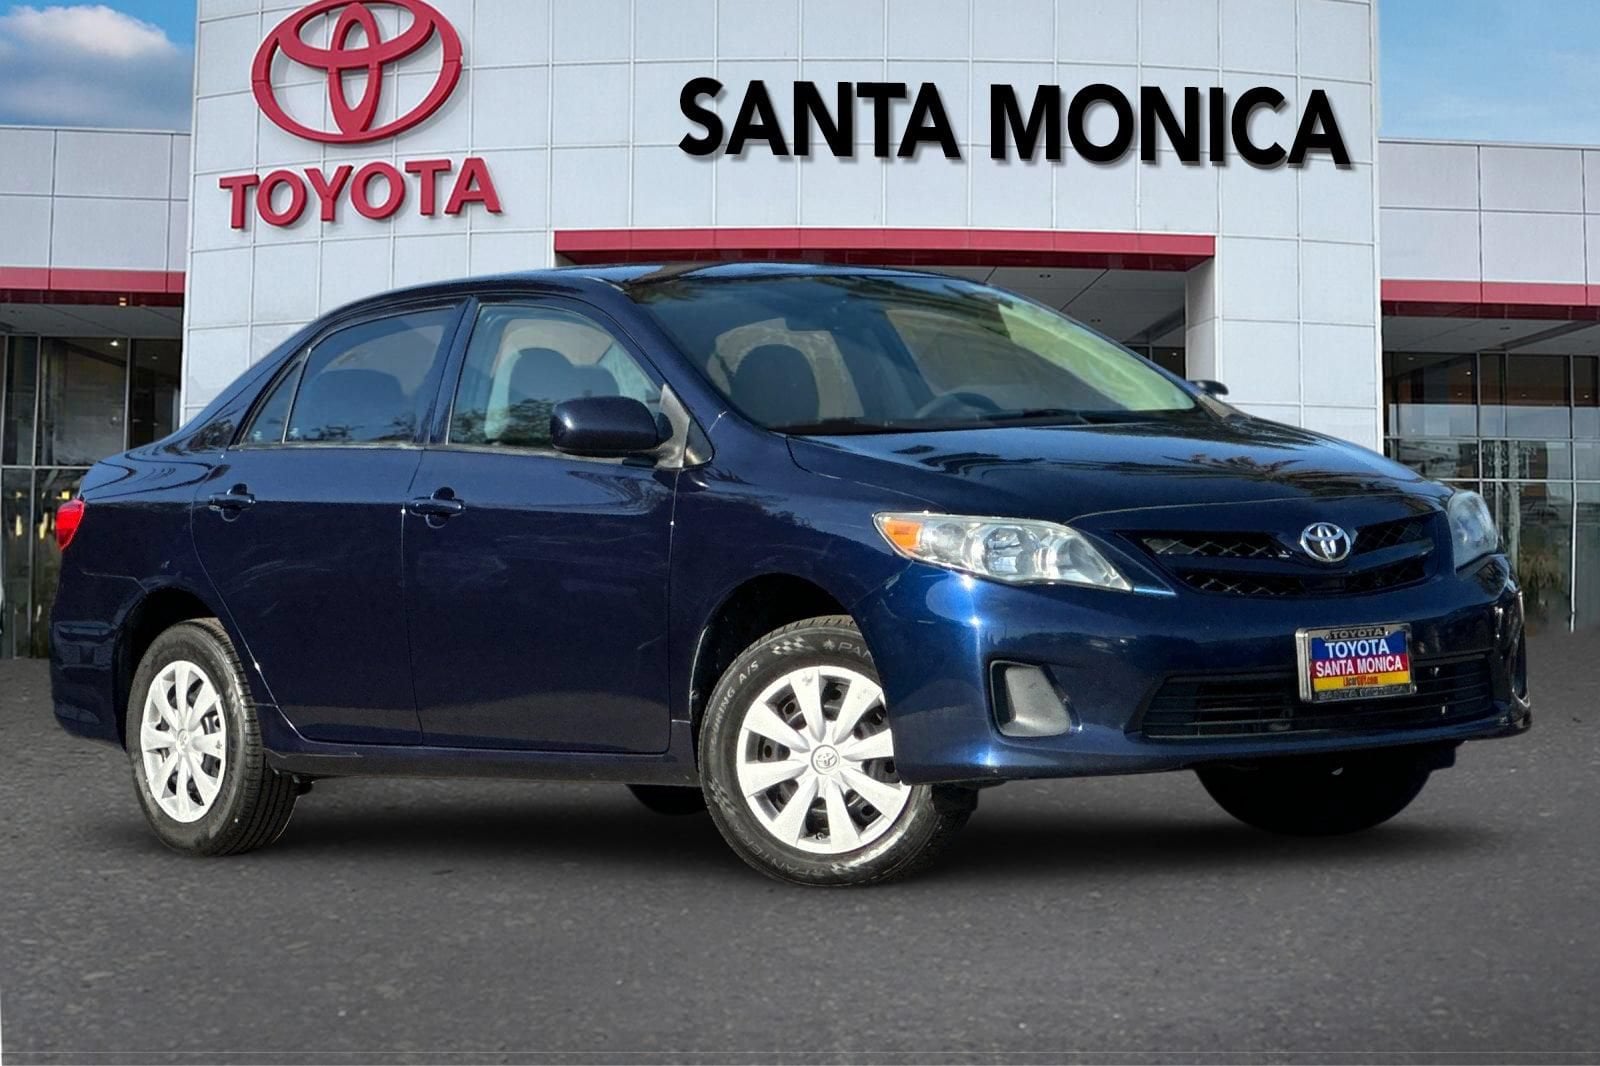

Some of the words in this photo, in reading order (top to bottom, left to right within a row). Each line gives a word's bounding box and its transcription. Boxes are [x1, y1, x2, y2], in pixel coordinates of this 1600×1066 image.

[678, 77, 962, 158] SANTA
[989, 83, 1351, 169] MONICA
[219, 157, 502, 229] TOYOTA
[1332, 628, 1384, 639] TOYOTA
[1324, 638, 1390, 658] TOYOTA
[739, 660, 759, 684] A/S
[1316, 659, 1355, 677] SANTA
[1357, 655, 1403, 674] MONICA
